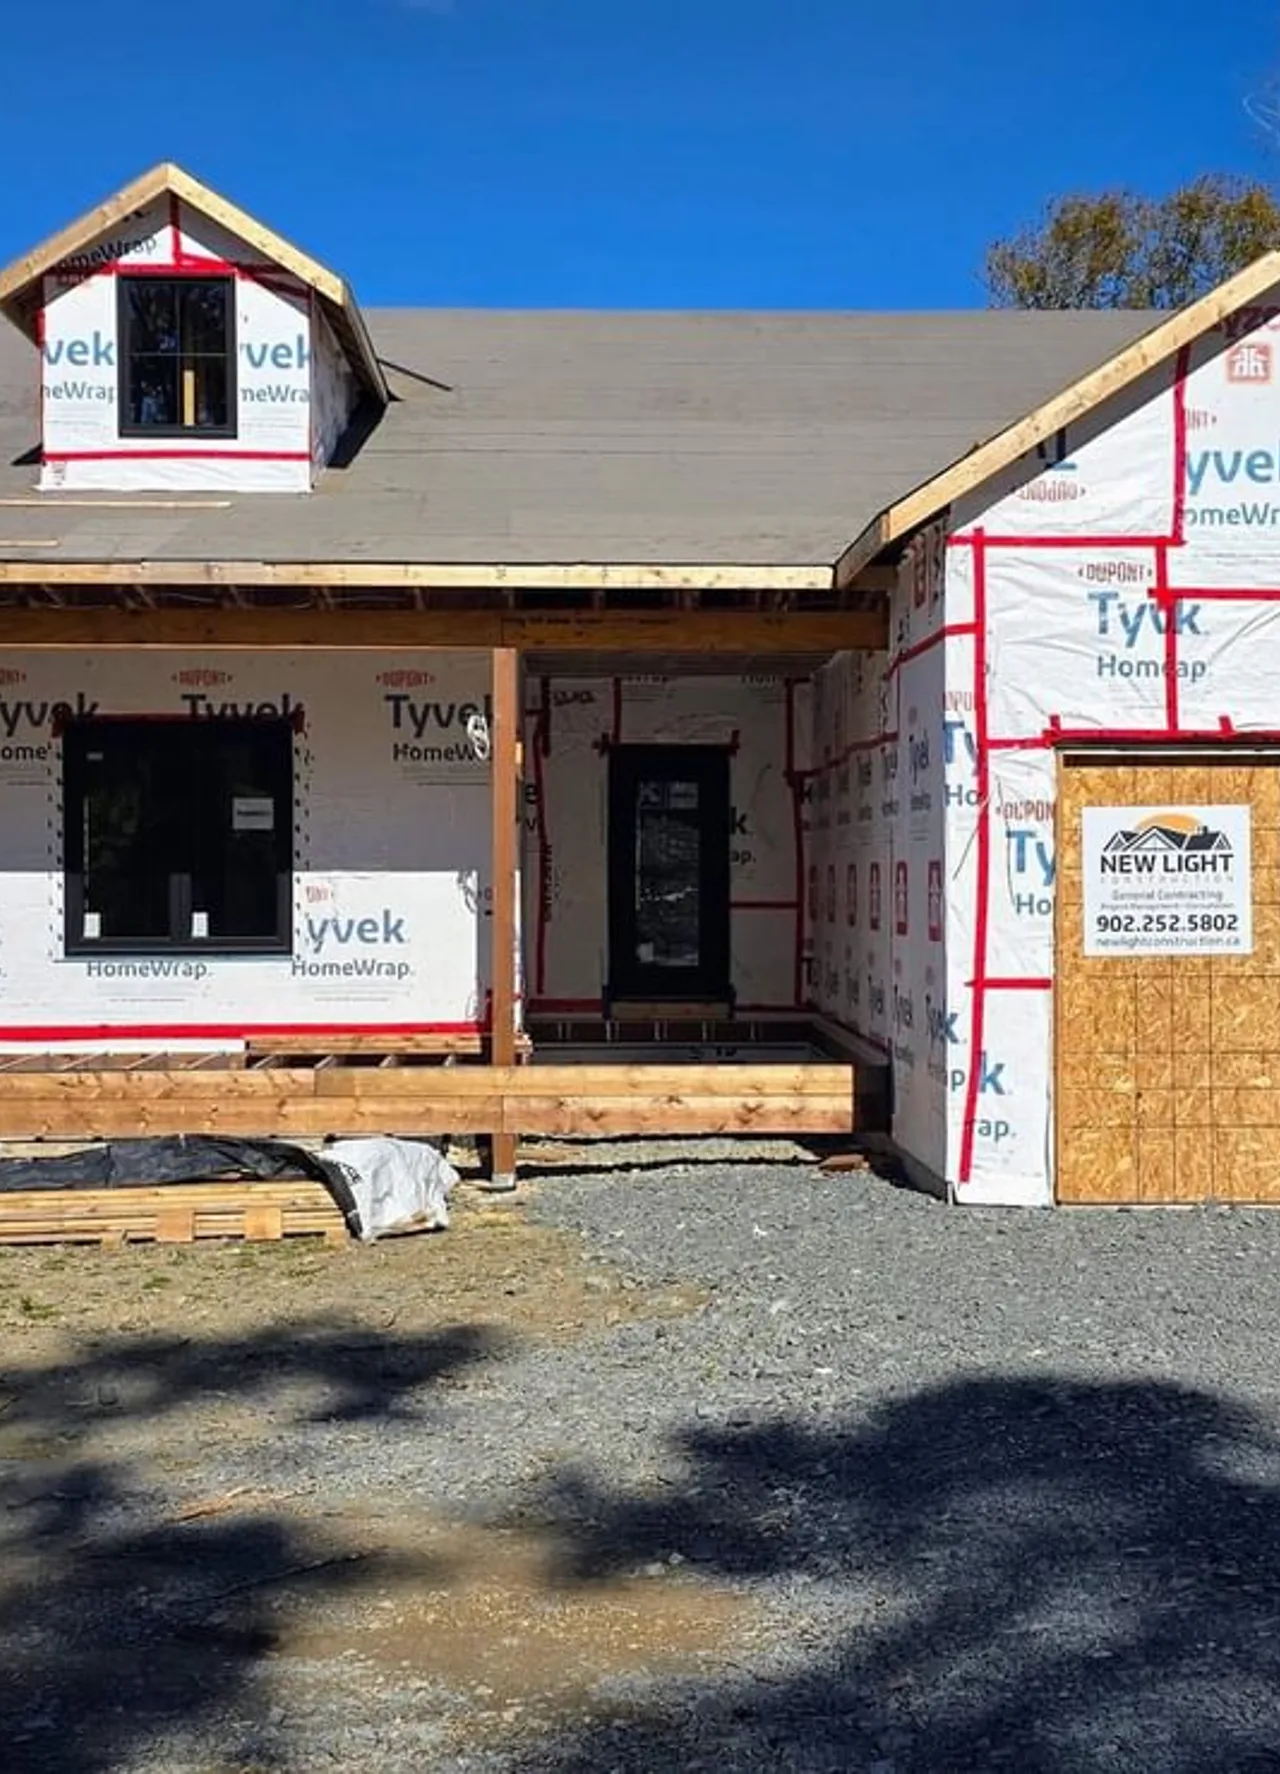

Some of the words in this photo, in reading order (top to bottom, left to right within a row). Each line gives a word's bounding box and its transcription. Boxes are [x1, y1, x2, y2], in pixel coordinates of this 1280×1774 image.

[43, 331, 114, 366] vek
[240, 334, 311, 369] vek
[393, 743, 473, 761] HomeW
[1100, 854, 1156, 873] NEW
[1163, 854, 1234, 872] LIGHT
[307, 909, 404, 952] yvek
[1096, 914, 1238, 932] 902.252.5802
[87, 960, 208, 980] HomeWrap
[291, 958, 410, 980] HomeWrap
